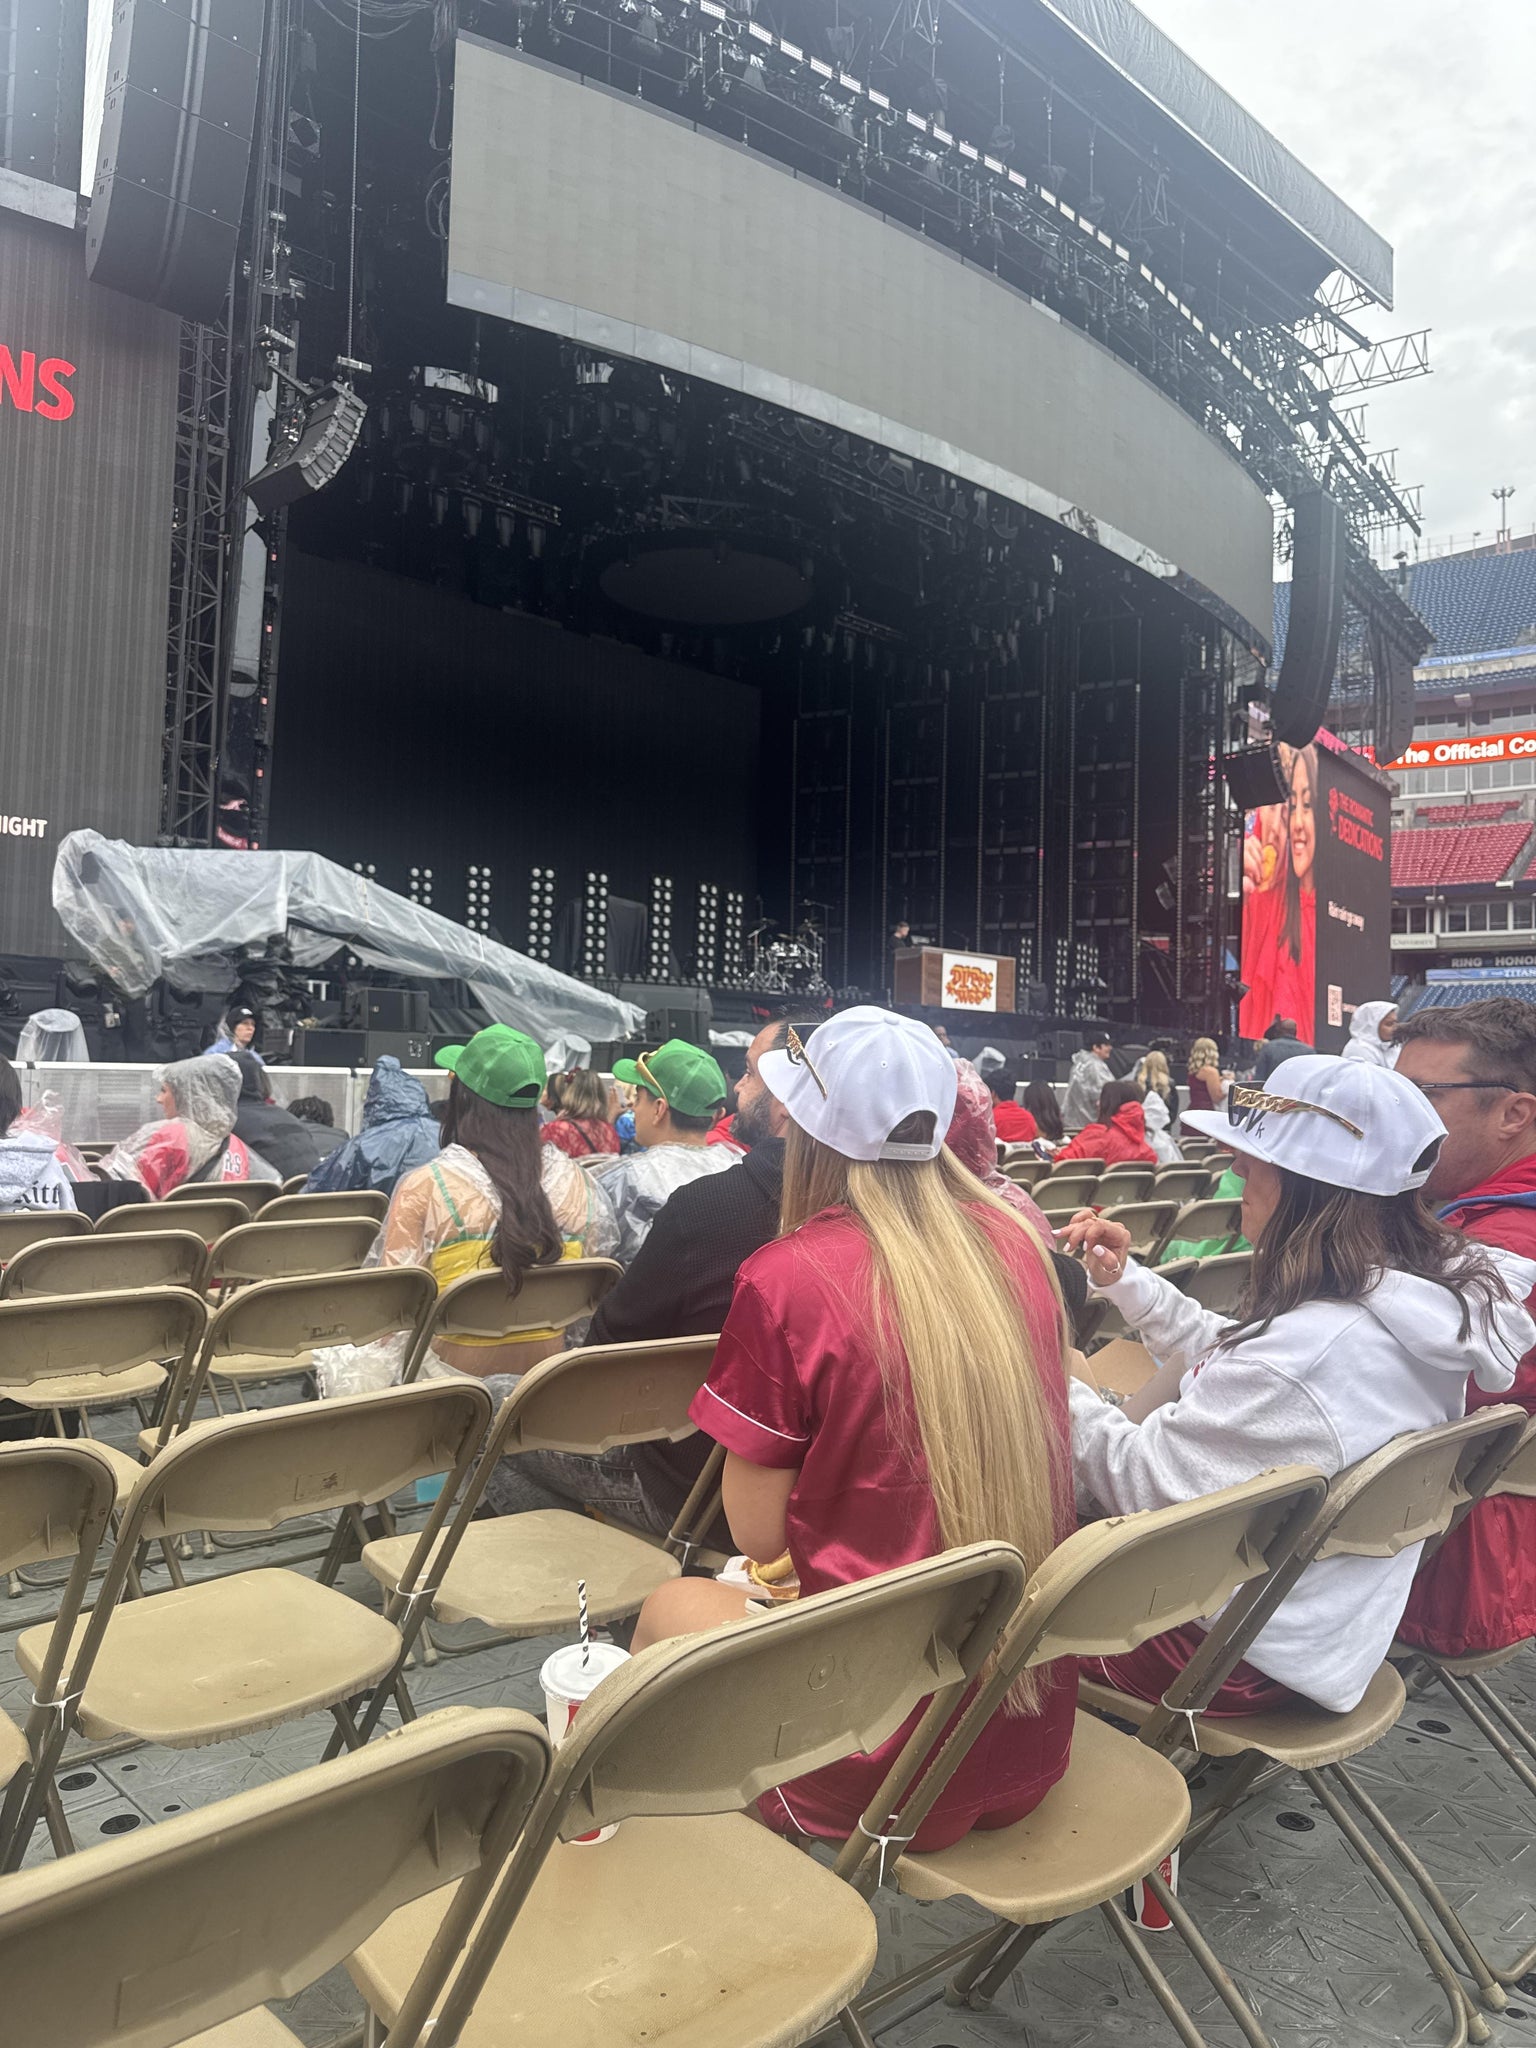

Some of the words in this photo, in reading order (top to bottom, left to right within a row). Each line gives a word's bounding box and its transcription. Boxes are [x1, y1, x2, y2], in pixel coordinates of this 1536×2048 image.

[1433, 739, 1505, 762] Official
[0, 814, 48, 838] IGHT
[1451, 957, 1482, 968] RING
[1495, 955, 1536, 967] HONO
